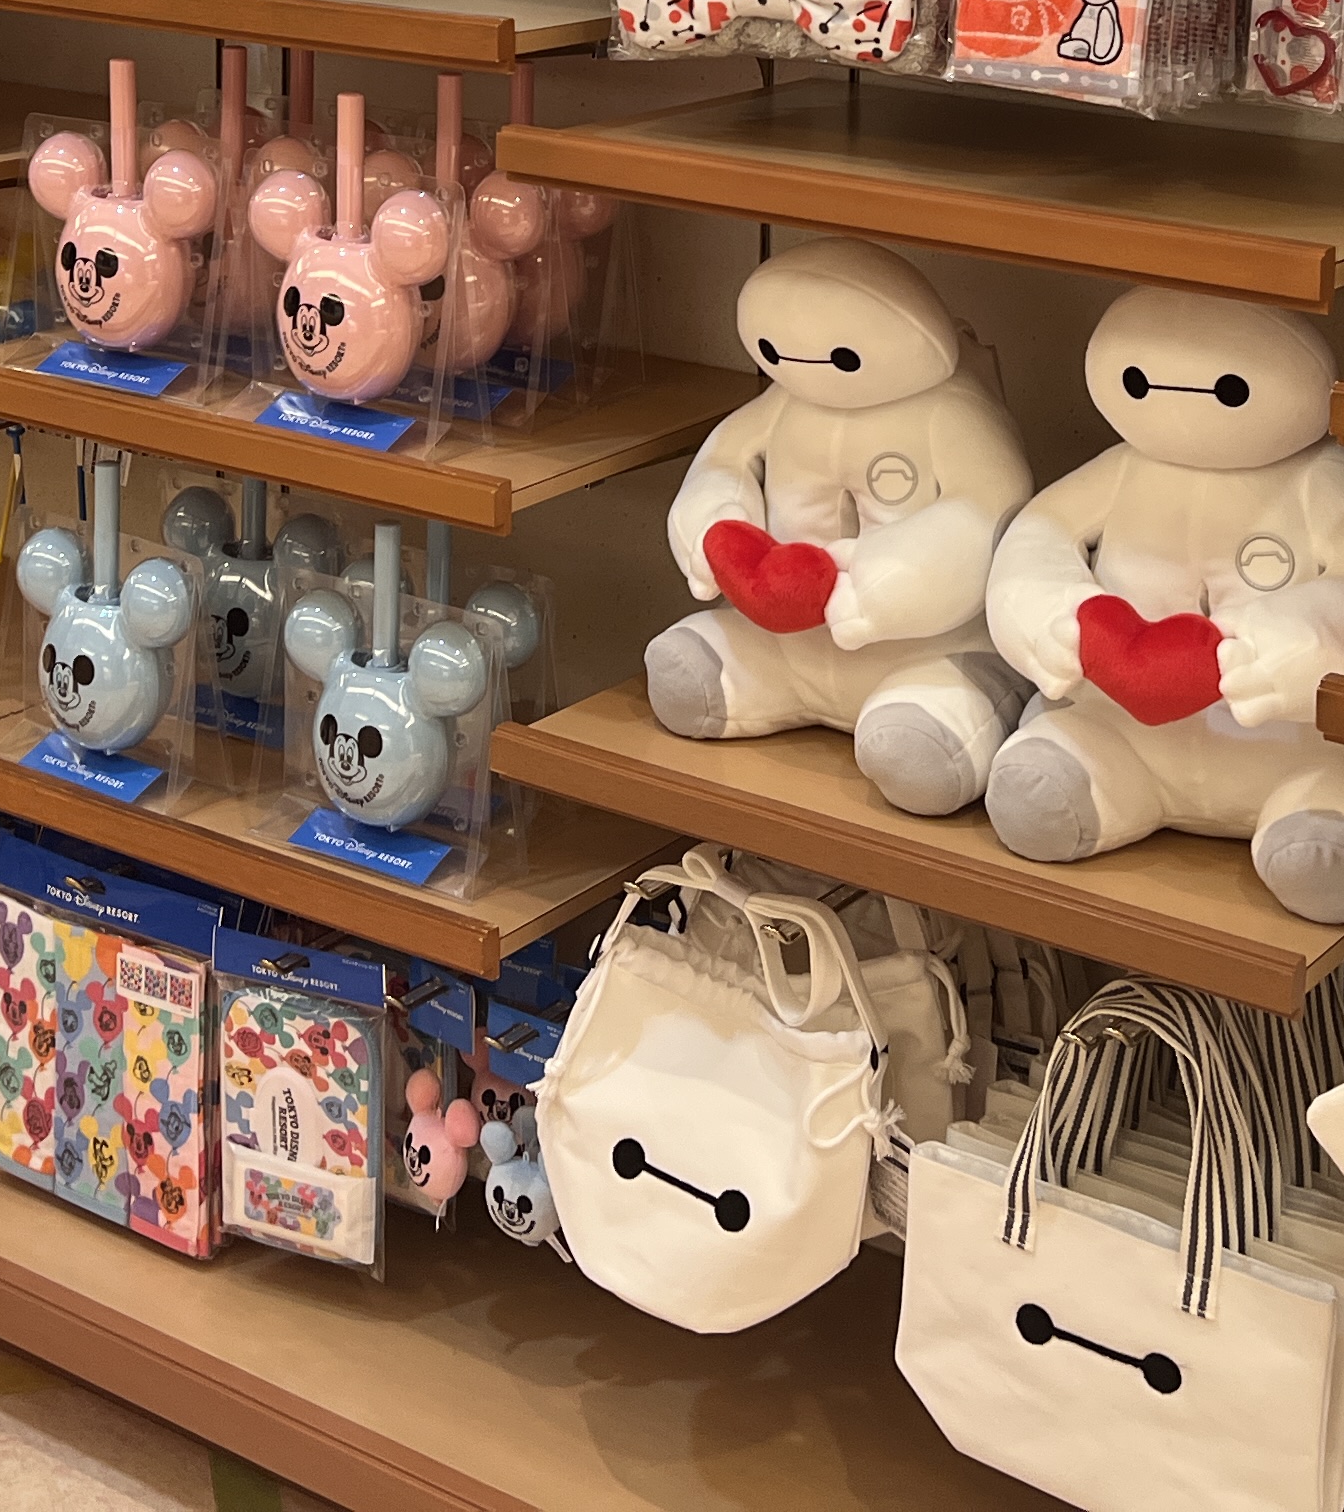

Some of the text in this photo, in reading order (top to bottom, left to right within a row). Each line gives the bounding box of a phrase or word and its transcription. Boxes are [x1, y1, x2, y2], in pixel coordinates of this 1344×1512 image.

[60, 360, 88, 371] TOKYO
[118, 372, 151, 384] RESORT
[278, 412, 307, 425] TOKYO
[341, 426, 375, 440] RESORT
[42, 754, 68, 768] TOKYO
[94, 773, 125, 789] RESORT
[313, 832, 344, 847] TOKYO
[377, 852, 413, 870] RESORT
[46, 883, 73, 903] TOKYO
[106, 905, 141, 924] RESORT
[251, 964, 278, 978] TOKYO
[310, 977, 340, 992] RESORT
[282, 1087, 299, 1130] TOKYO
[278, 1105, 289, 1152] RESORT
